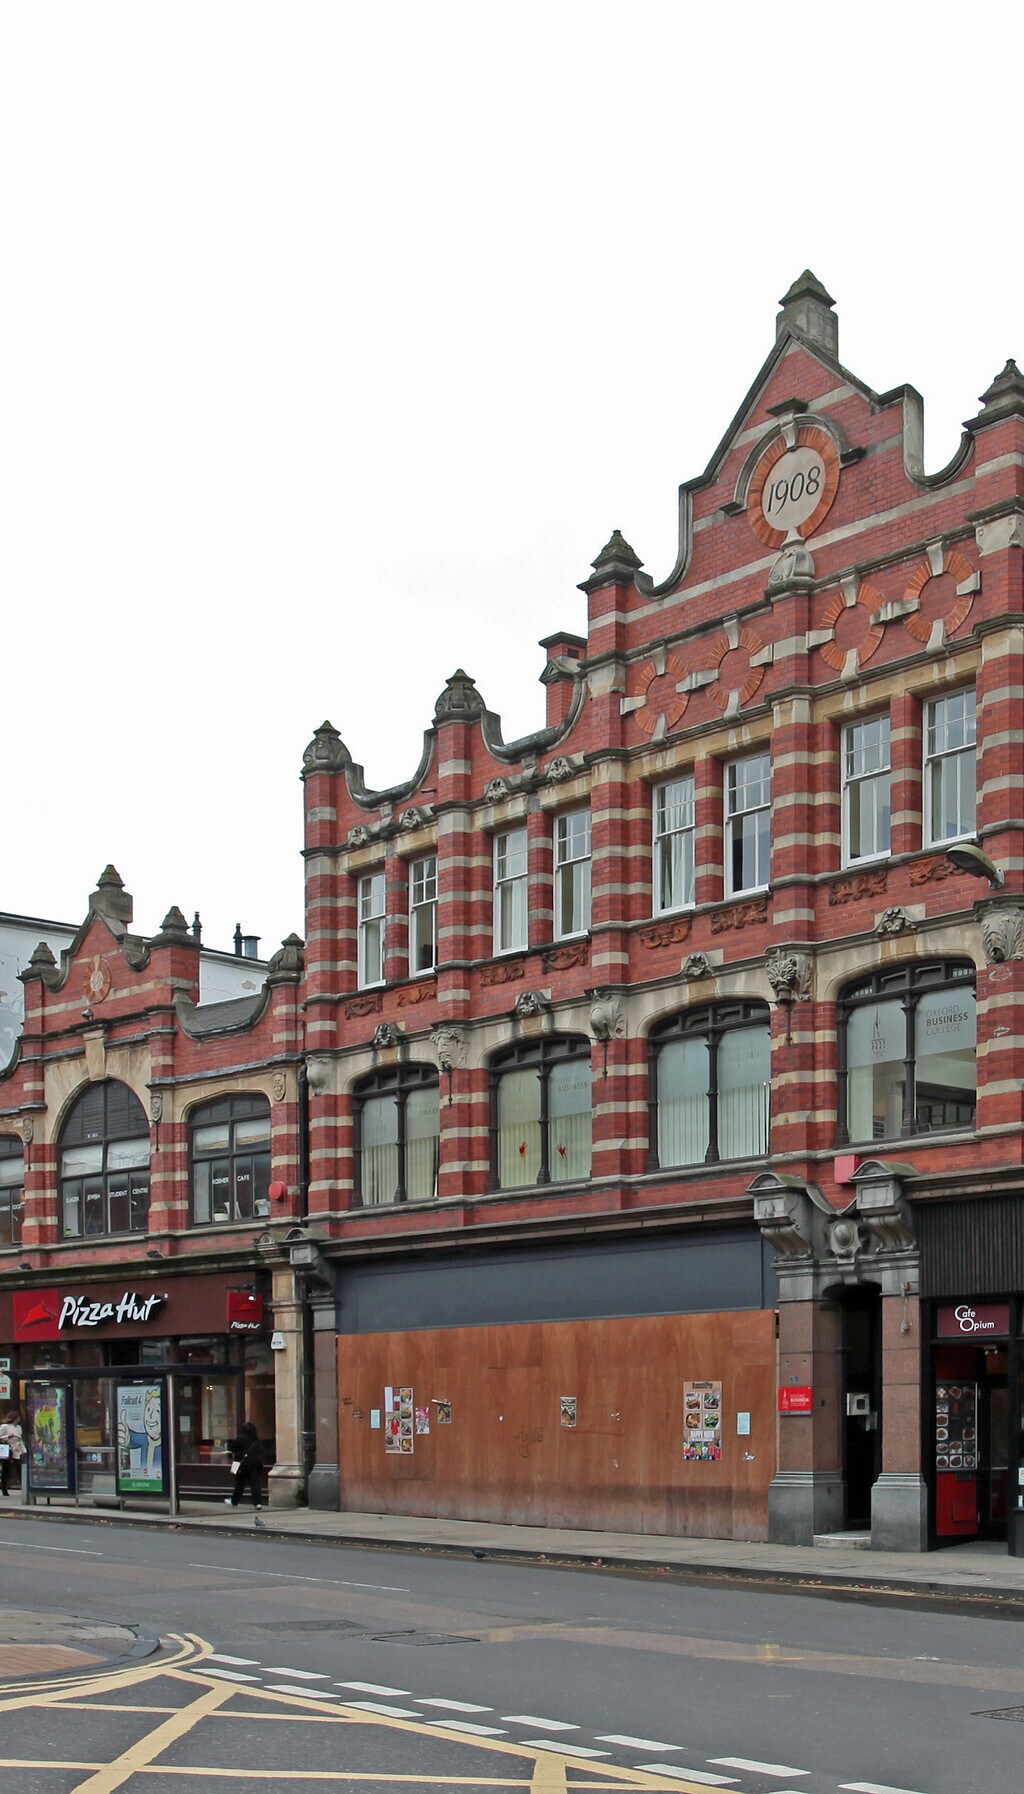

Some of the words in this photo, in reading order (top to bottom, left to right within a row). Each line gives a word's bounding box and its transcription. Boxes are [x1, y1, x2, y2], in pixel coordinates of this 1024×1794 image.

[767, 465, 821, 516] 1908
[925, 1005, 960, 1018] OXFORD
[926, 1012, 969, 1027] BUSINESS
[926, 1023, 961, 1036] COLLEGE
[237, 1174, 250, 1182] CAFE
[58, 1295, 114, 1330] Pizza
[115, 1292, 161, 1323] Hut
[954, 1305, 976, 1321] Cafe
[960, 1317, 995, 1332] Opium
[121, 1395, 138, 1405] Fallout
